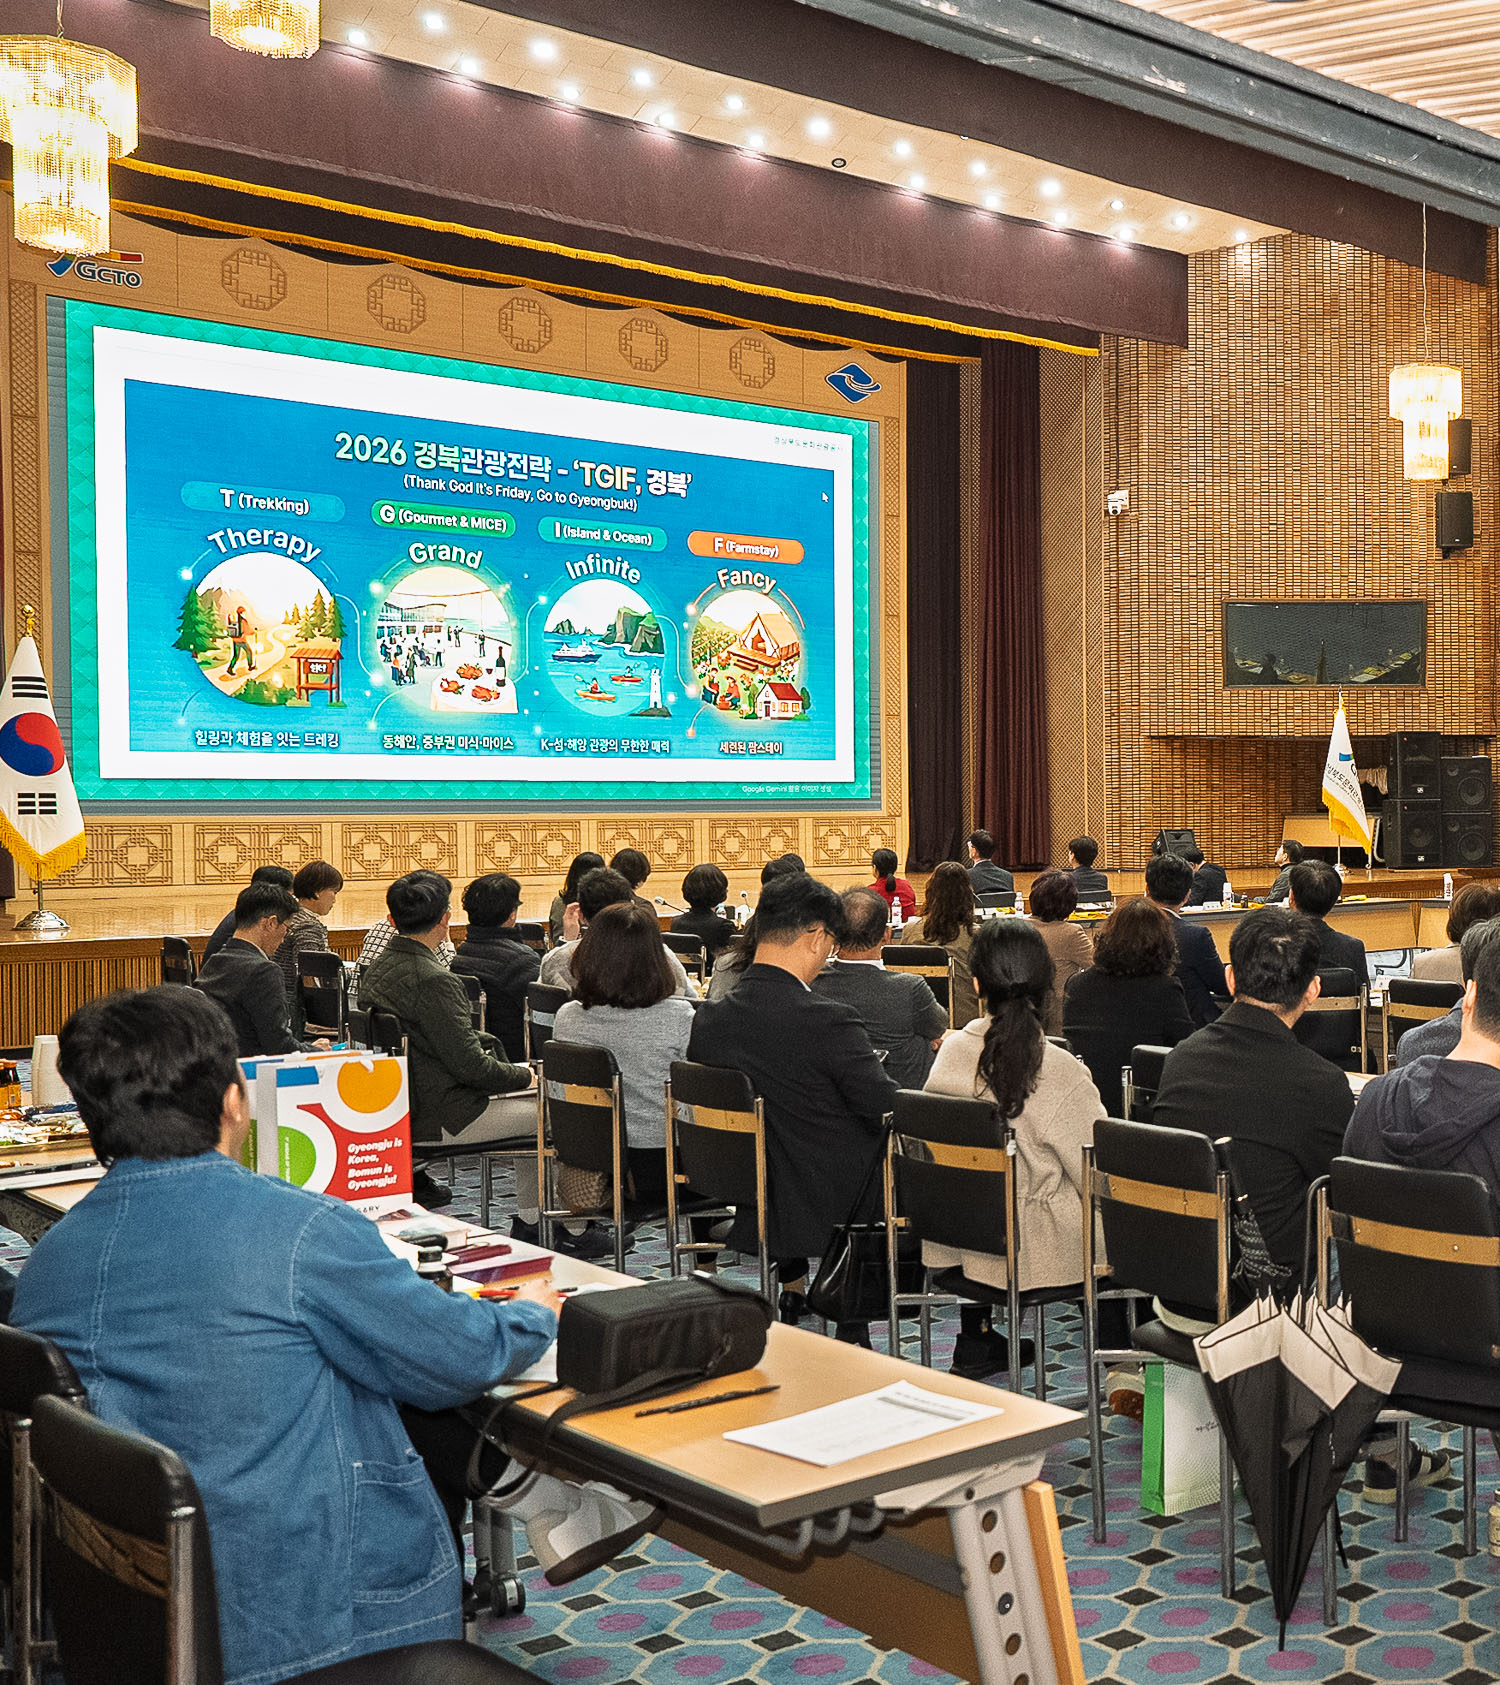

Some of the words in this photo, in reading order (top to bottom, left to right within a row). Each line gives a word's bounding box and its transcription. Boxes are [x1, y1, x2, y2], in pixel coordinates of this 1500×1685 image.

[75, 261, 142, 288] GCTO
[335, 432, 407, 466] 2026
[414, 441, 551, 482] 경북관광전략
[219, 488, 235, 508] T
[238, 492, 310, 515] (Trekking)
[403, 474, 446, 492] (Thank
[449, 478, 473, 494] God
[475, 481, 493, 496] It's
[495, 483, 534, 502] Friday,
[536, 488, 552, 502] Go
[554, 490, 567, 504] to
[569, 492, 638, 512] Gyeongbuk!)
[379, 505, 395, 523] G
[398, 507, 458, 528] (Gourmet
[460, 516, 469, 529] &
[470, 517, 507, 533] MICE)
[207, 527, 322, 564] Therapy
[563, 525, 600, 540] (Island
[602, 529, 611, 541] &
[612, 530, 652, 546] Ocean)
[408, 542, 483, 570] Grand
[714, 537, 724, 552] F
[725, 540, 779, 558] (Farmstay)
[565, 553, 641, 584] Infinite
[717, 569, 777, 595] Fancy
[194, 730, 233, 747] 힐링과
[236, 731, 273, 747] 체험을
[276, 733, 301, 747] 잇는
[303, 733, 339, 748] 트레킹
[382, 735, 420, 750] 동해안,
[422, 735, 455, 750] 중부권
[589, 739, 618, 753] 관광의
[620, 739, 650, 753] 무한한
[651, 740, 670, 754] 매력
[719, 741, 746, 754] 세련된
[748, 741, 783, 755] 팜스테이
[742, 785, 765, 793] Google
[766, 785, 787, 793] Gemini
[801, 785, 819, 793] 이미지
[347, 1139, 393, 1154] Gyeongju
[394, 1138, 403, 1148] is
[347, 1155, 379, 1165] Korea,
[347, 1166, 382, 1178] Bomun
[383, 1164, 393, 1174] is
[347, 1175, 398, 1191] Gyeongju!
